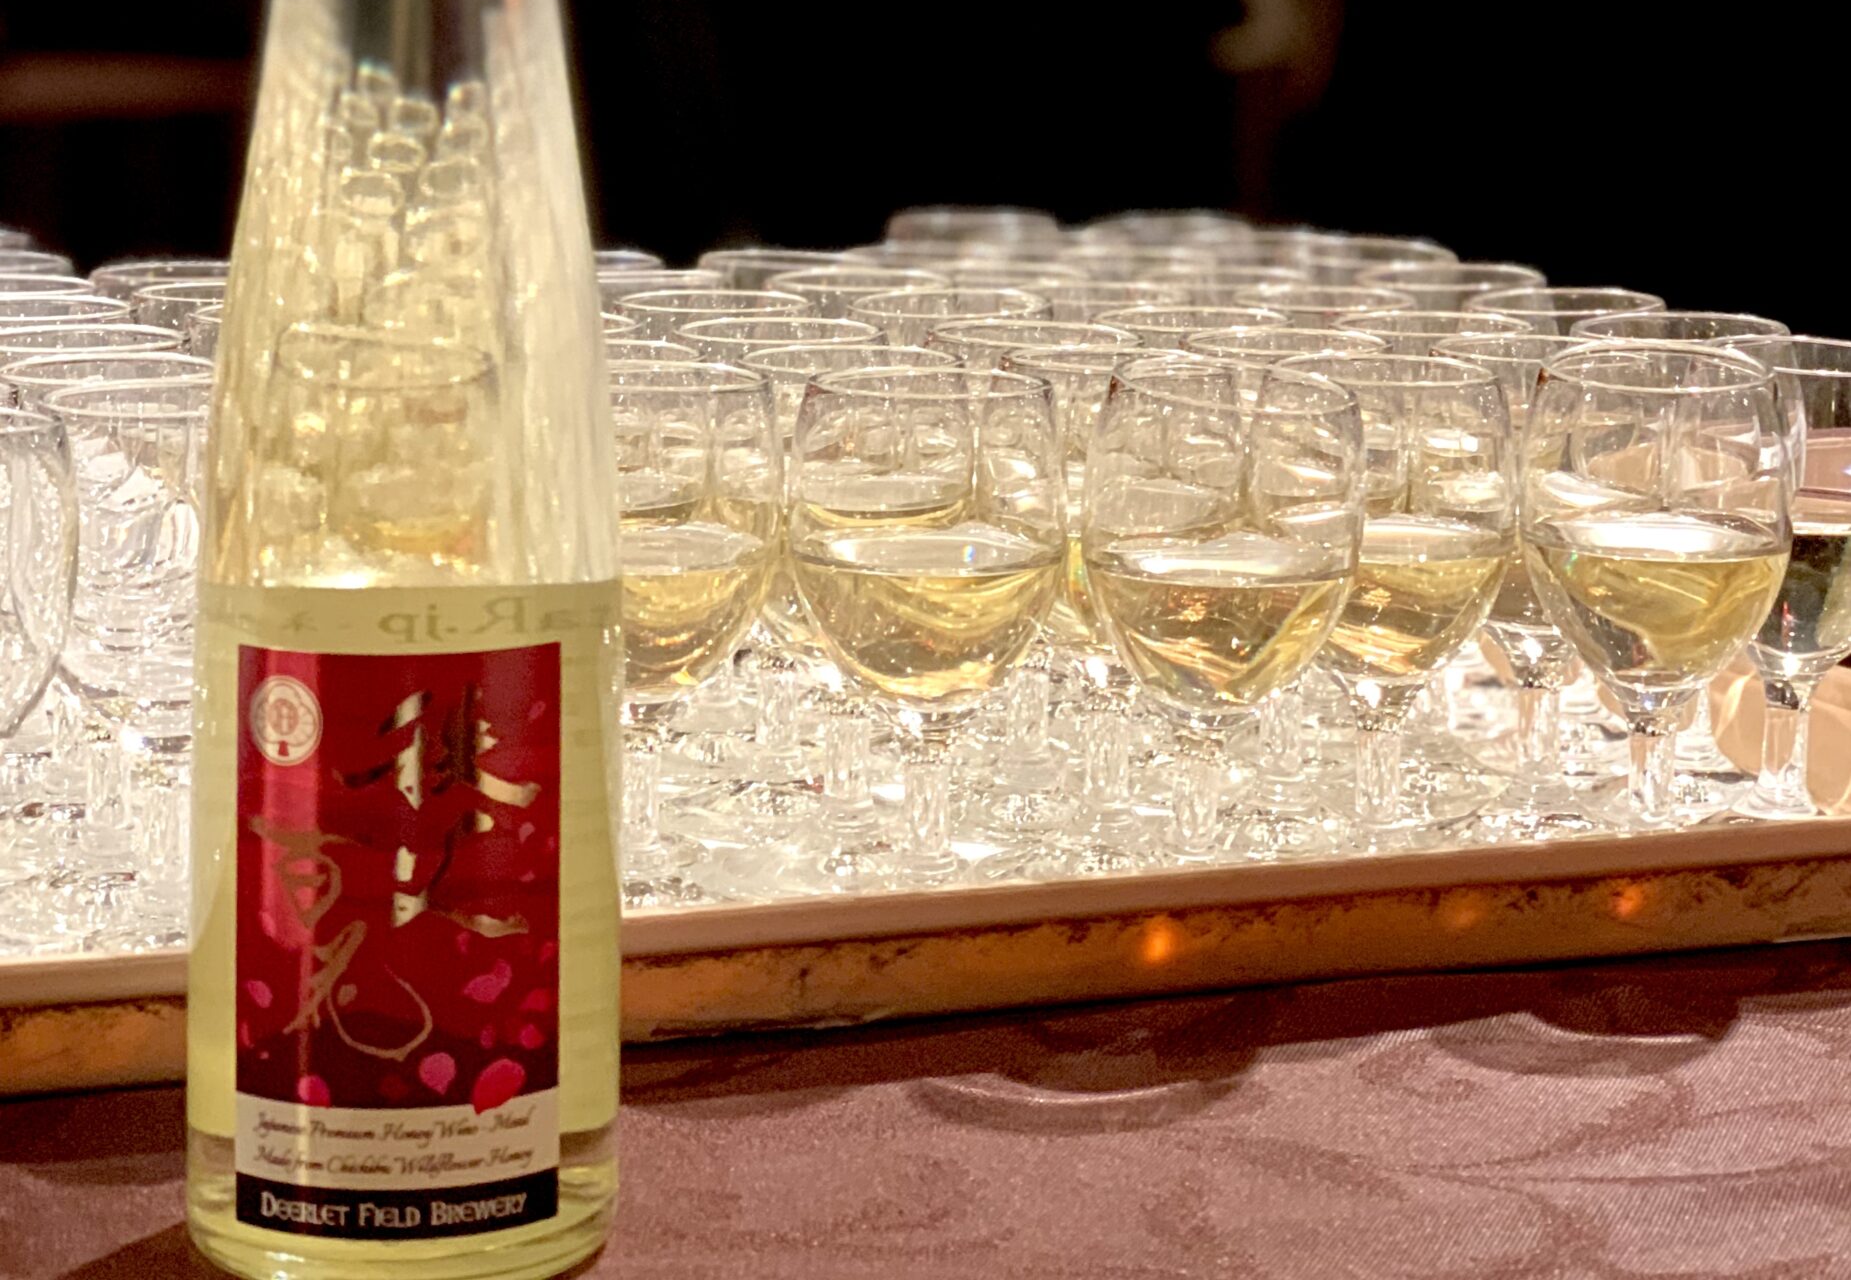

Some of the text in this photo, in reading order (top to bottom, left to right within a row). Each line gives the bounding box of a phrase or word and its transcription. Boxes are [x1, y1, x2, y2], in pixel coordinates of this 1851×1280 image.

[309, 1119, 375, 1147] Premium
[379, 1123, 433, 1149] Honey
[434, 1116, 478, 1139] Wine
[484, 1145, 535, 1169] Honey
[260, 1190, 528, 1229] DEERLET FIELD BREWERY
